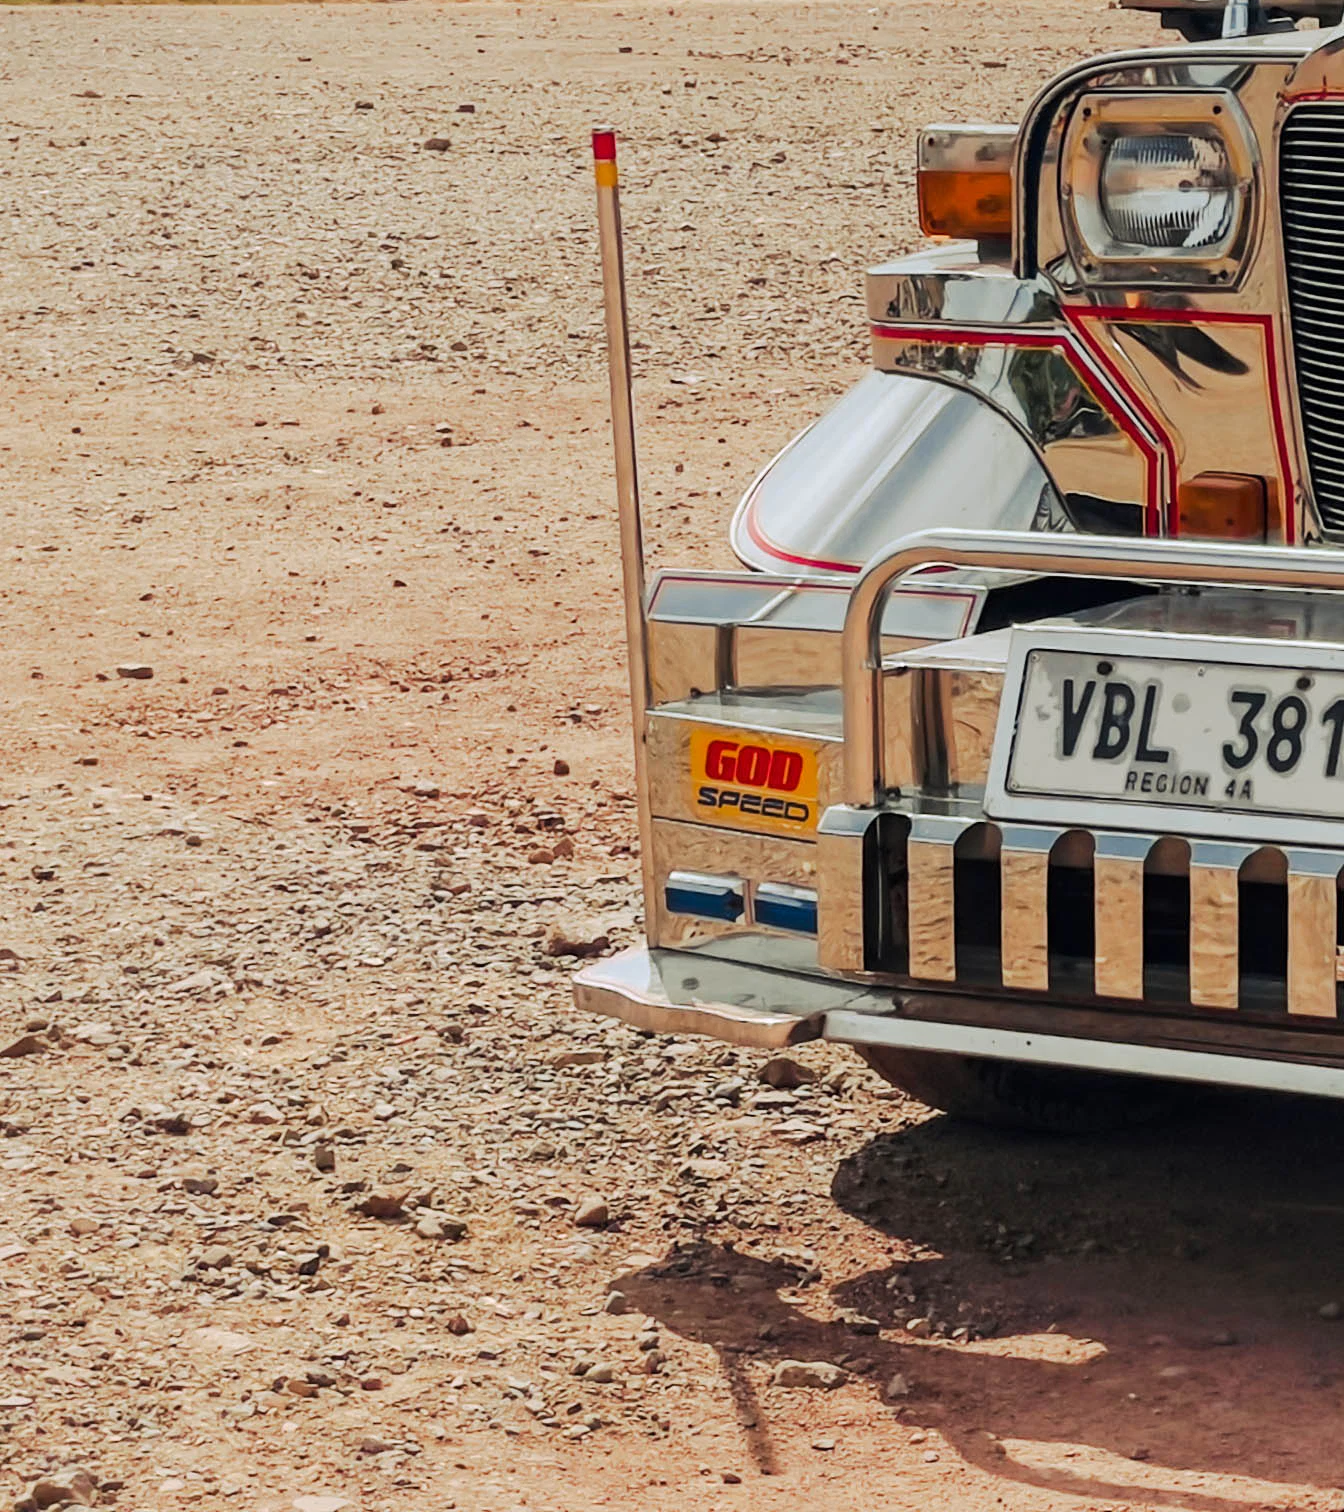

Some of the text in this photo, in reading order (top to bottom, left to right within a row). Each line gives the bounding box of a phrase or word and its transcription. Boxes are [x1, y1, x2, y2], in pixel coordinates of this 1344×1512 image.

[1061, 678, 1169, 763] VBL
[705, 740, 803, 792] GOD
[1124, 771, 1253, 800] REGION 4A
[697, 786, 809, 822] SPEED
